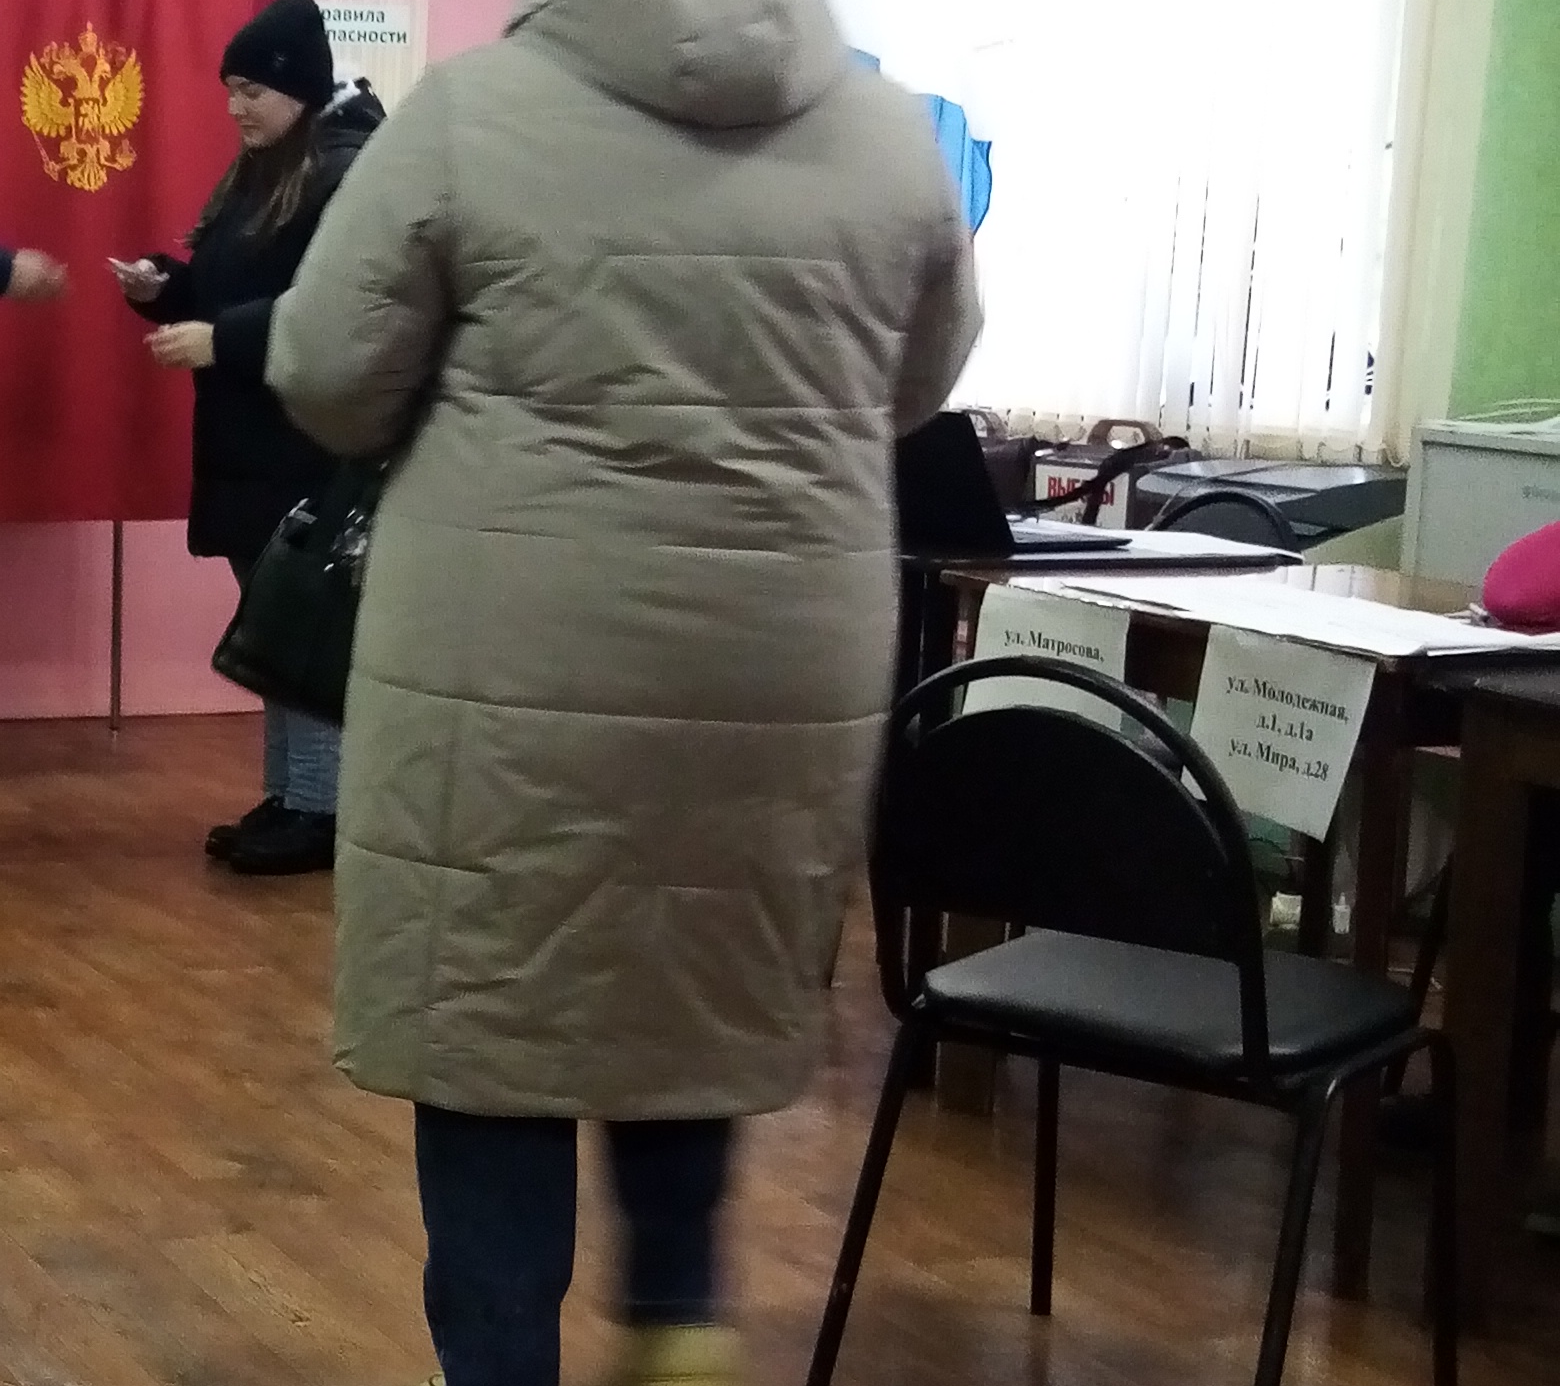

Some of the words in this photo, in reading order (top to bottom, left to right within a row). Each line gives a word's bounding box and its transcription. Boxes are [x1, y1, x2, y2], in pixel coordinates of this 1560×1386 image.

[320, 7, 386, 24] равила
[324, 29, 408, 44] пасности
[1004, 629, 1025, 647] ул.
[1029, 630, 1105, 663] Матросова,
[1226, 676, 1249, 694] ул.
[1253, 678, 1350, 725] Молодежная,
[1284, 721, 1314, 742] д.1а
[1228, 738, 1252, 757] ул.
[1257, 741, 1300, 774] Мира,
[1302, 760, 1330, 781] д.28
